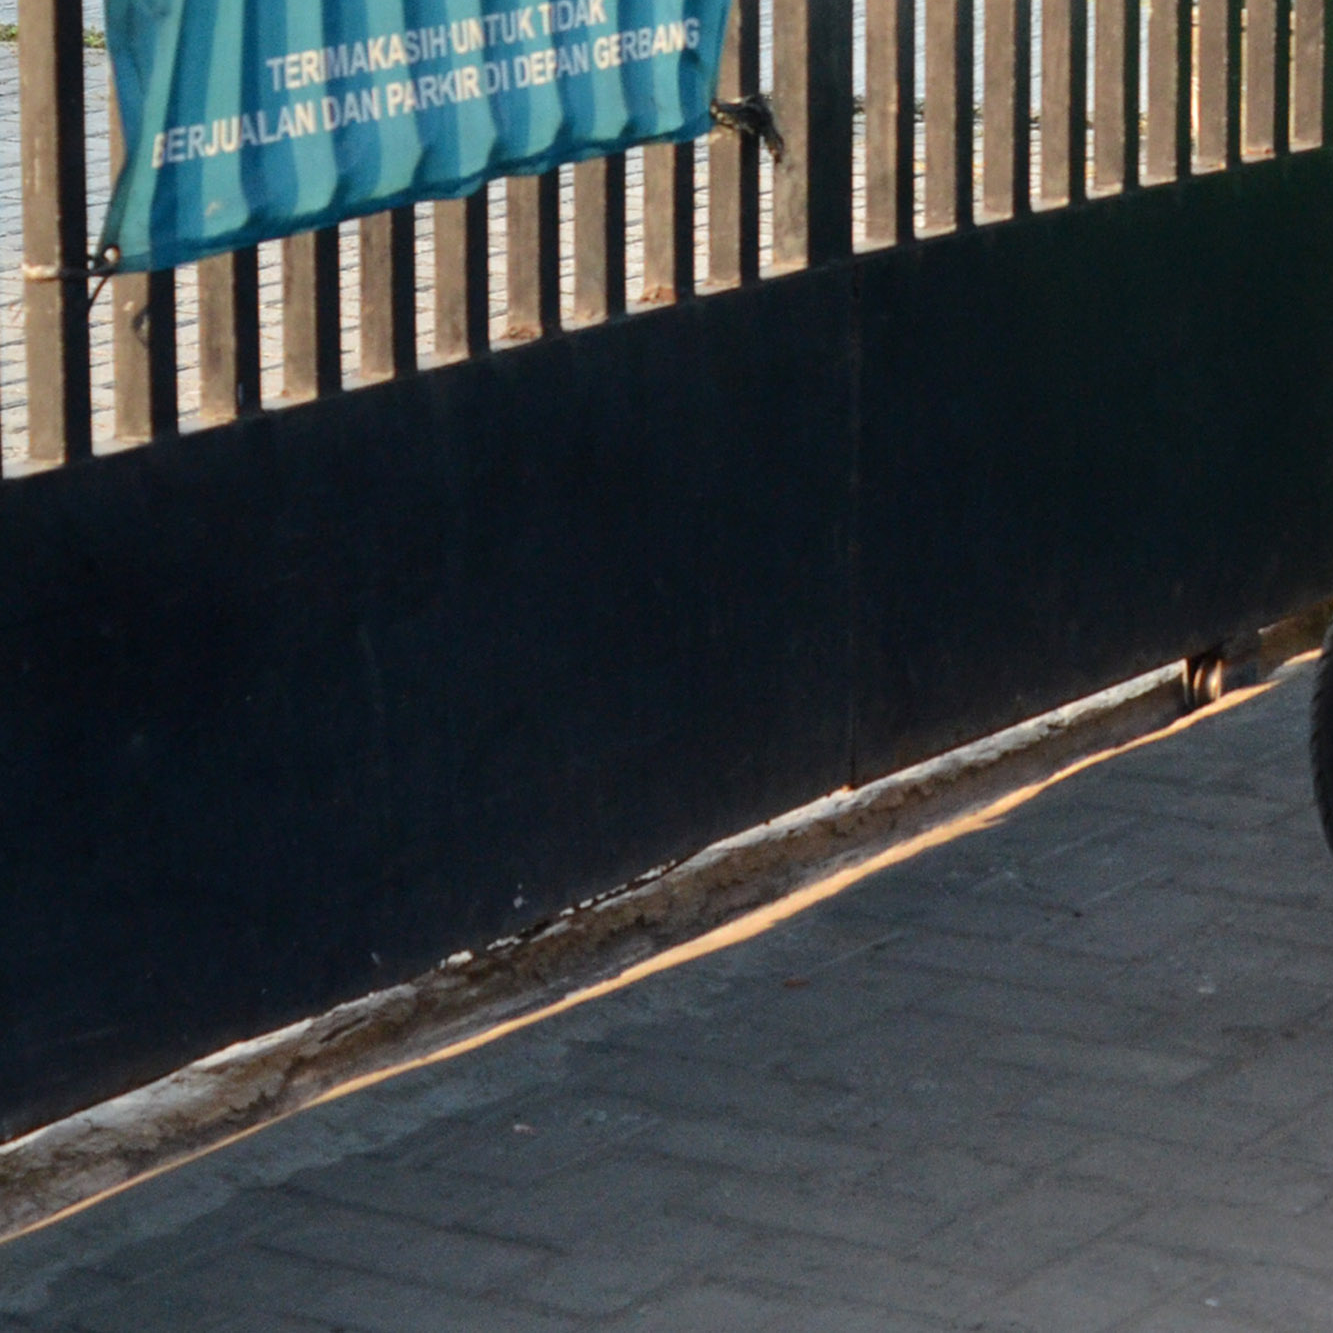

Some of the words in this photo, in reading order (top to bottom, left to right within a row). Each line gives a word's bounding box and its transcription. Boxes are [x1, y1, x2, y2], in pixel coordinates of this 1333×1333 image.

[266, 23, 448, 92] TERIMAKASIH
[450, 5, 536, 55] UNTUK
[321, 86, 382, 132] DAN
[386, 64, 483, 115] PARKIR
[486, 57, 510, 96] DI
[514, 41, 591, 90] DEPAN
[592, 17, 701, 70] GERBANG
